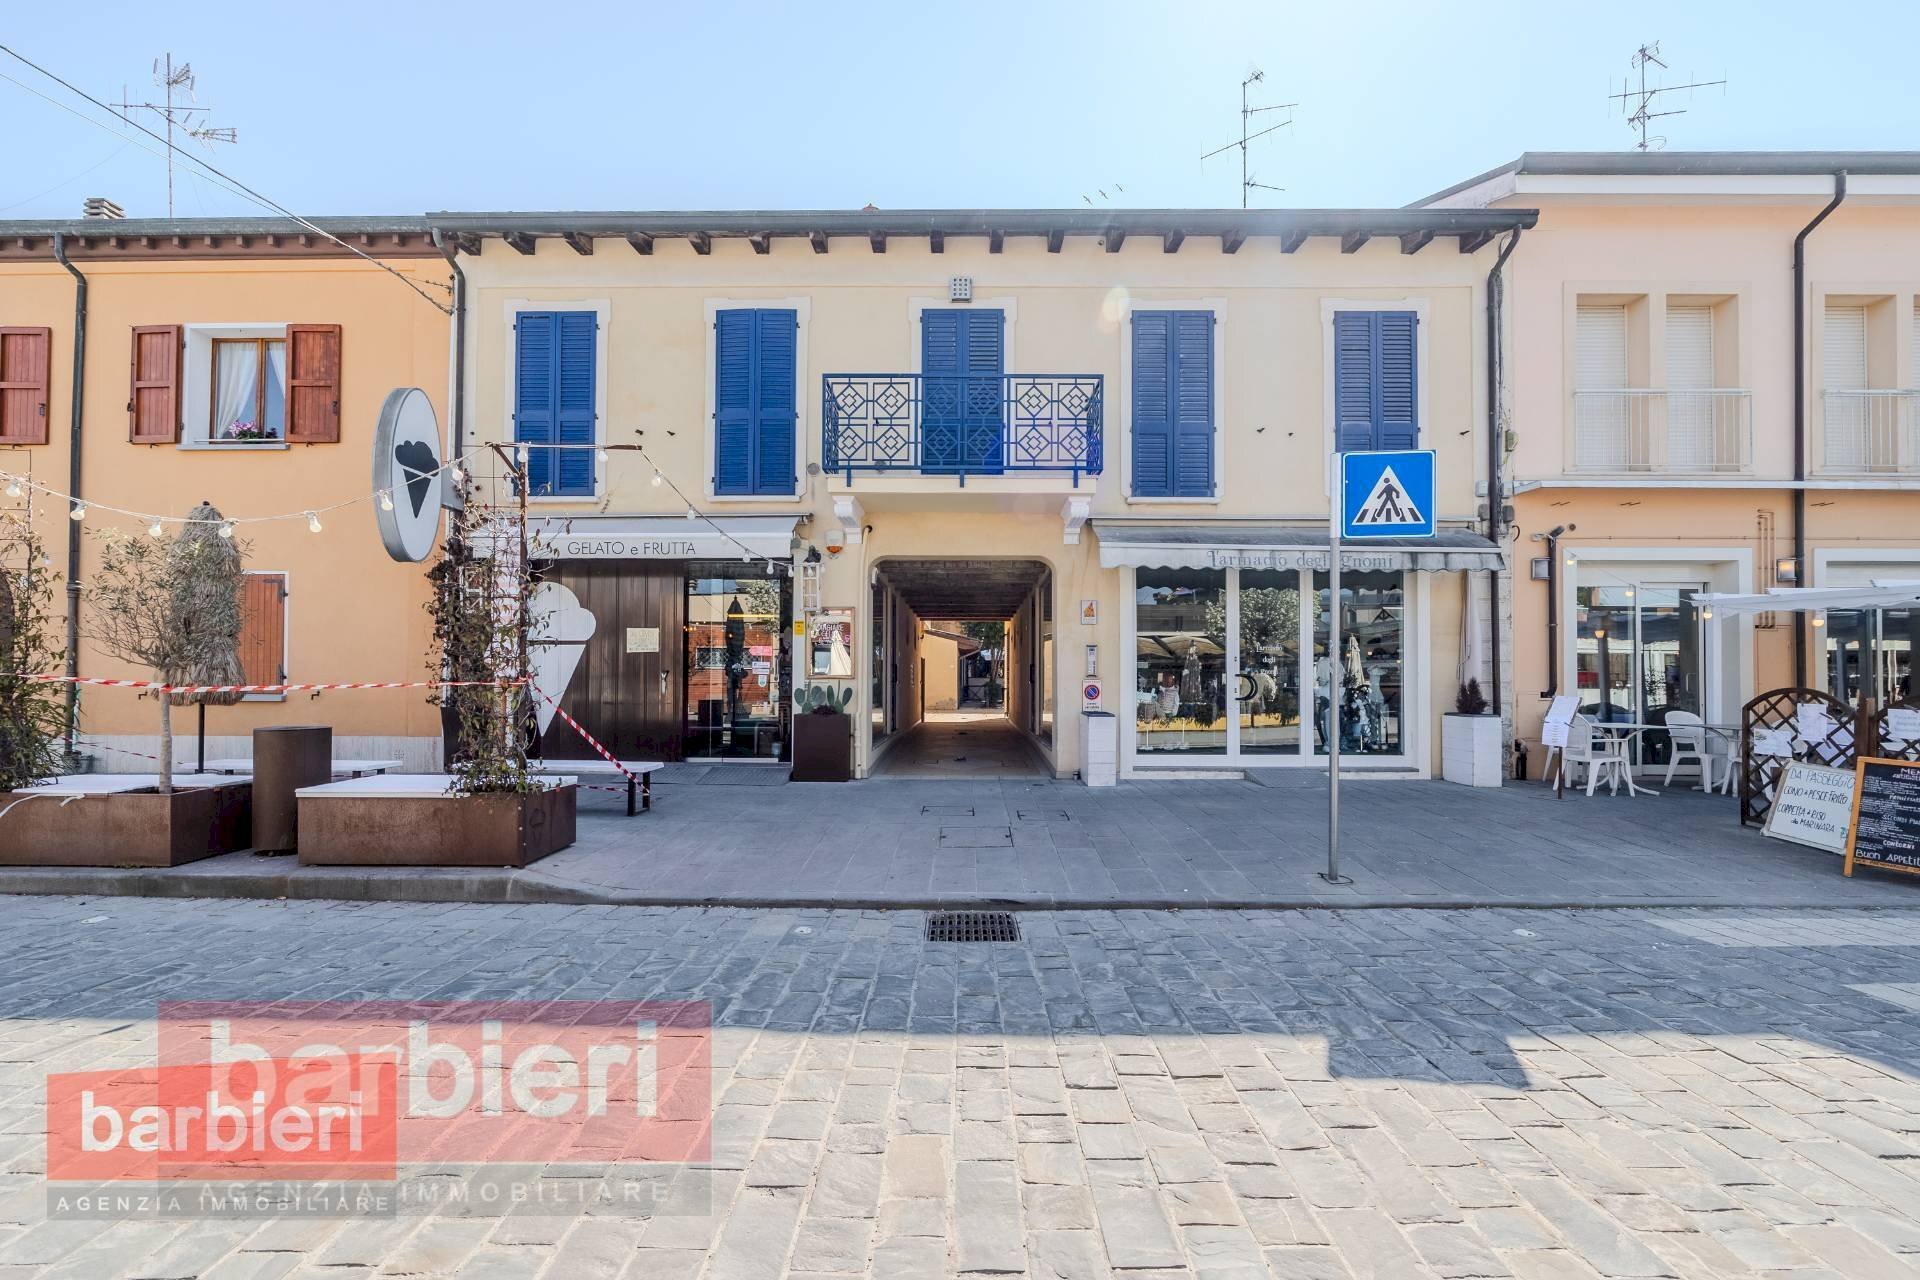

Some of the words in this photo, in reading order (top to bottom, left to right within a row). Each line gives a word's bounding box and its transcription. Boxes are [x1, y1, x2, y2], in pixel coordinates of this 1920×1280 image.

[567, 541, 625, 555] GELATO
[630, 546, 638, 555] e
[643, 542, 696, 555] FRUTTA
[1297, 552, 1331, 570] degl
[1340, 555, 1393, 571] gnomi
